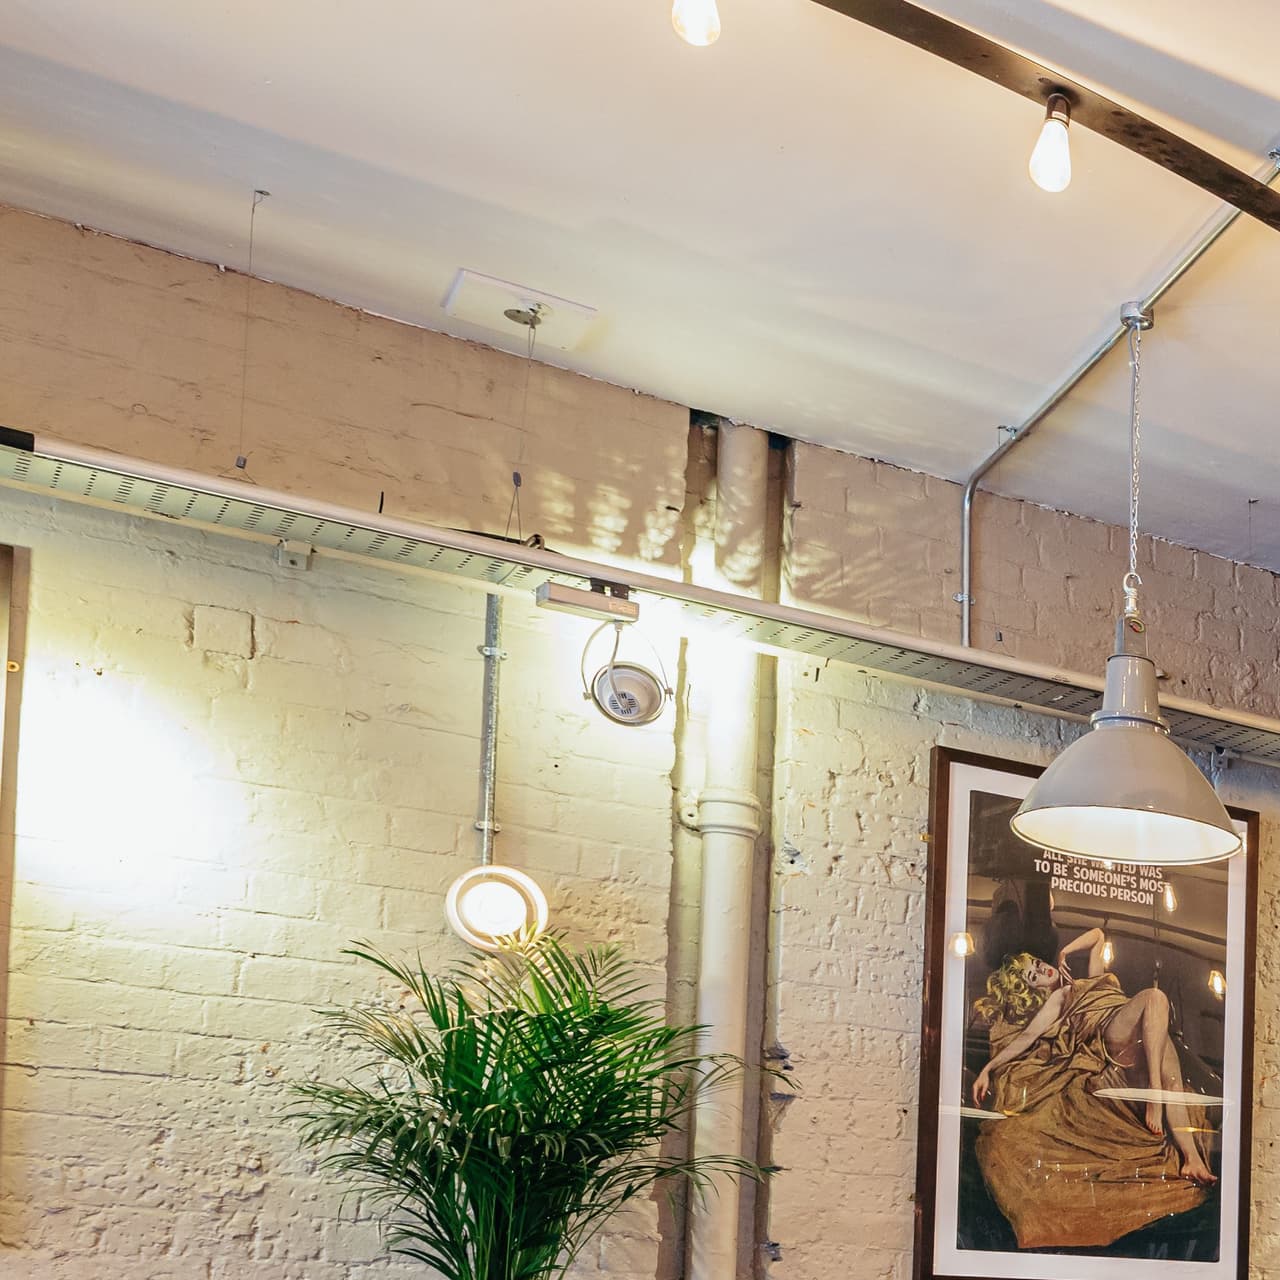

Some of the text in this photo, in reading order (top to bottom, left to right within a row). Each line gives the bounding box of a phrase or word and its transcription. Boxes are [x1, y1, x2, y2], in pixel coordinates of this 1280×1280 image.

[1034, 859, 1171, 893] TO BE SOMEONE'S MOST
[1139, 865, 1163, 879] WAS
[1051, 876, 1154, 906] PRECIOUS PERSON
